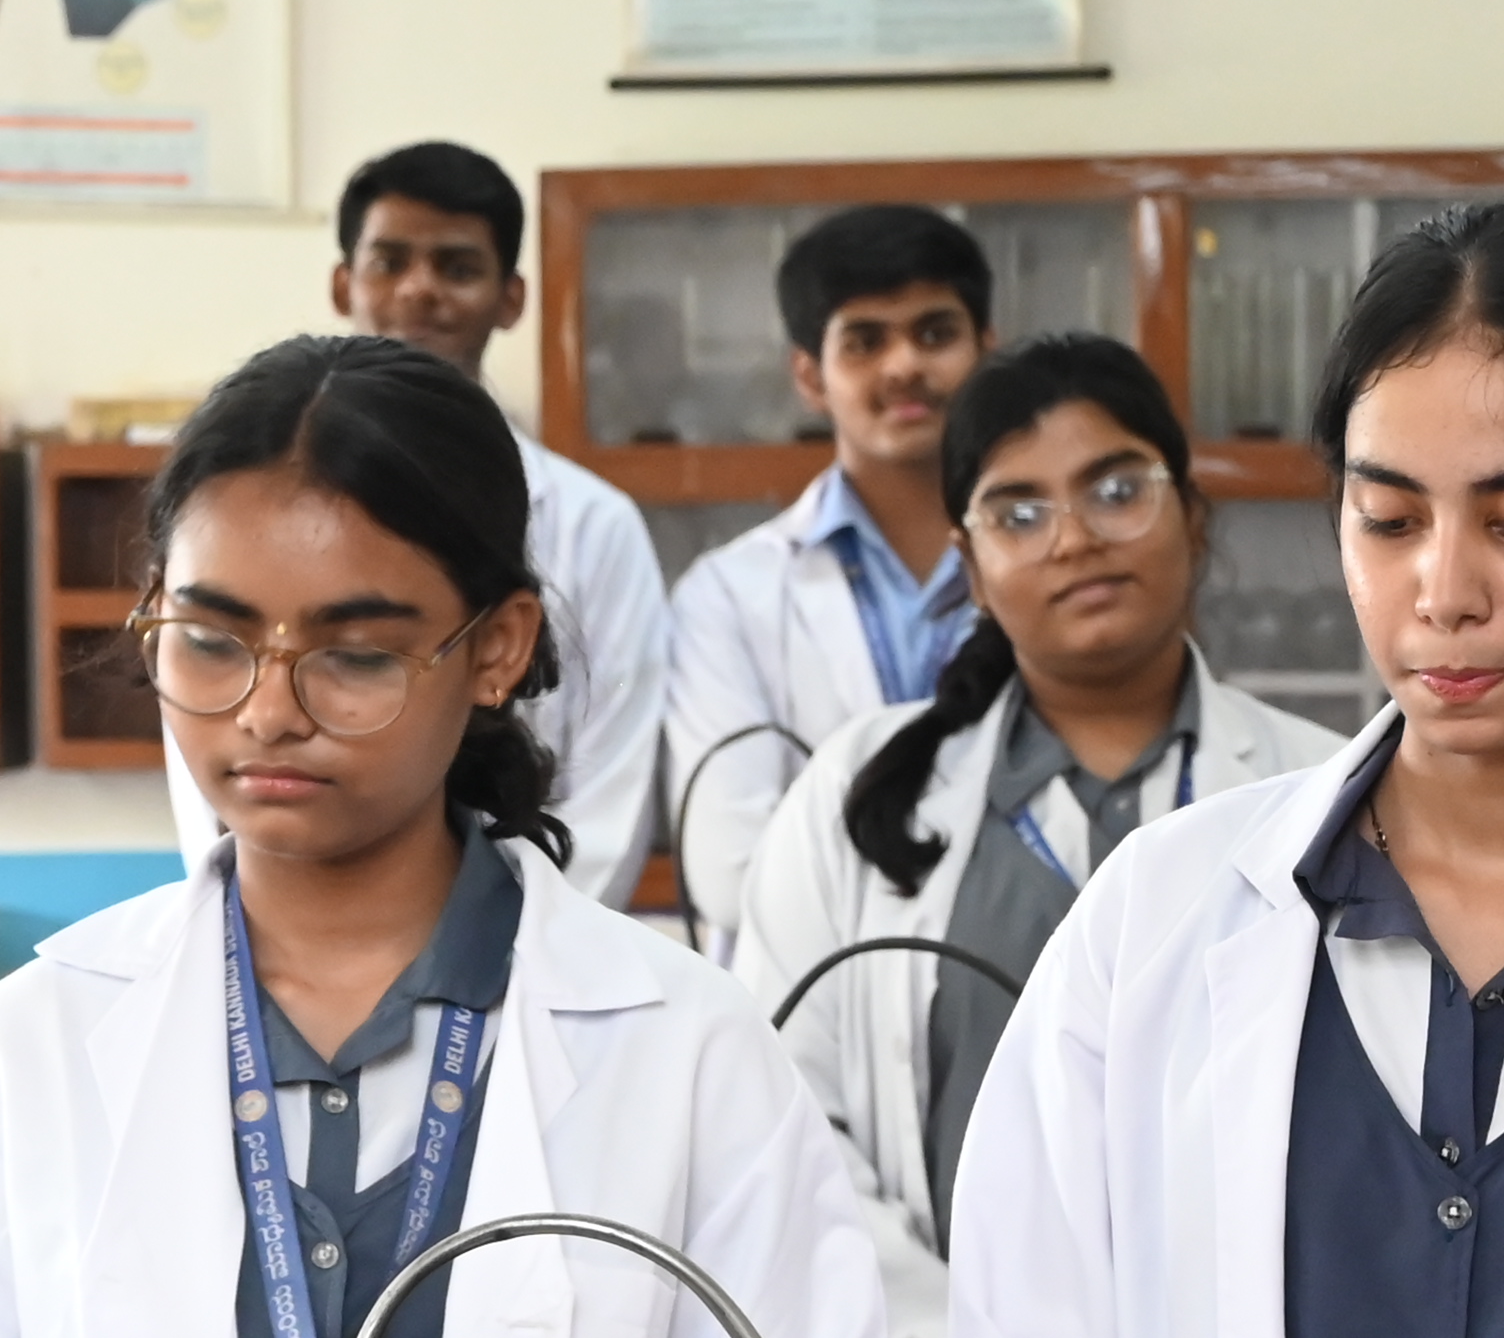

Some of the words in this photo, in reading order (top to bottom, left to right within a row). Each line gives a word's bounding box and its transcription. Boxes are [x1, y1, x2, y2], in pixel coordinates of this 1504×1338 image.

[225, 955, 247, 1031] KANNADA
[230, 1031, 256, 1084] DELHI
[443, 1024, 470, 1075] DELHI
[242, 1131, 270, 1175] ಶಾಲೆ
[424, 1117, 447, 1165] ಶಾಲೆ
[252, 1179, 290, 1281] ಮಾಧ್ಯಮಿಕ
